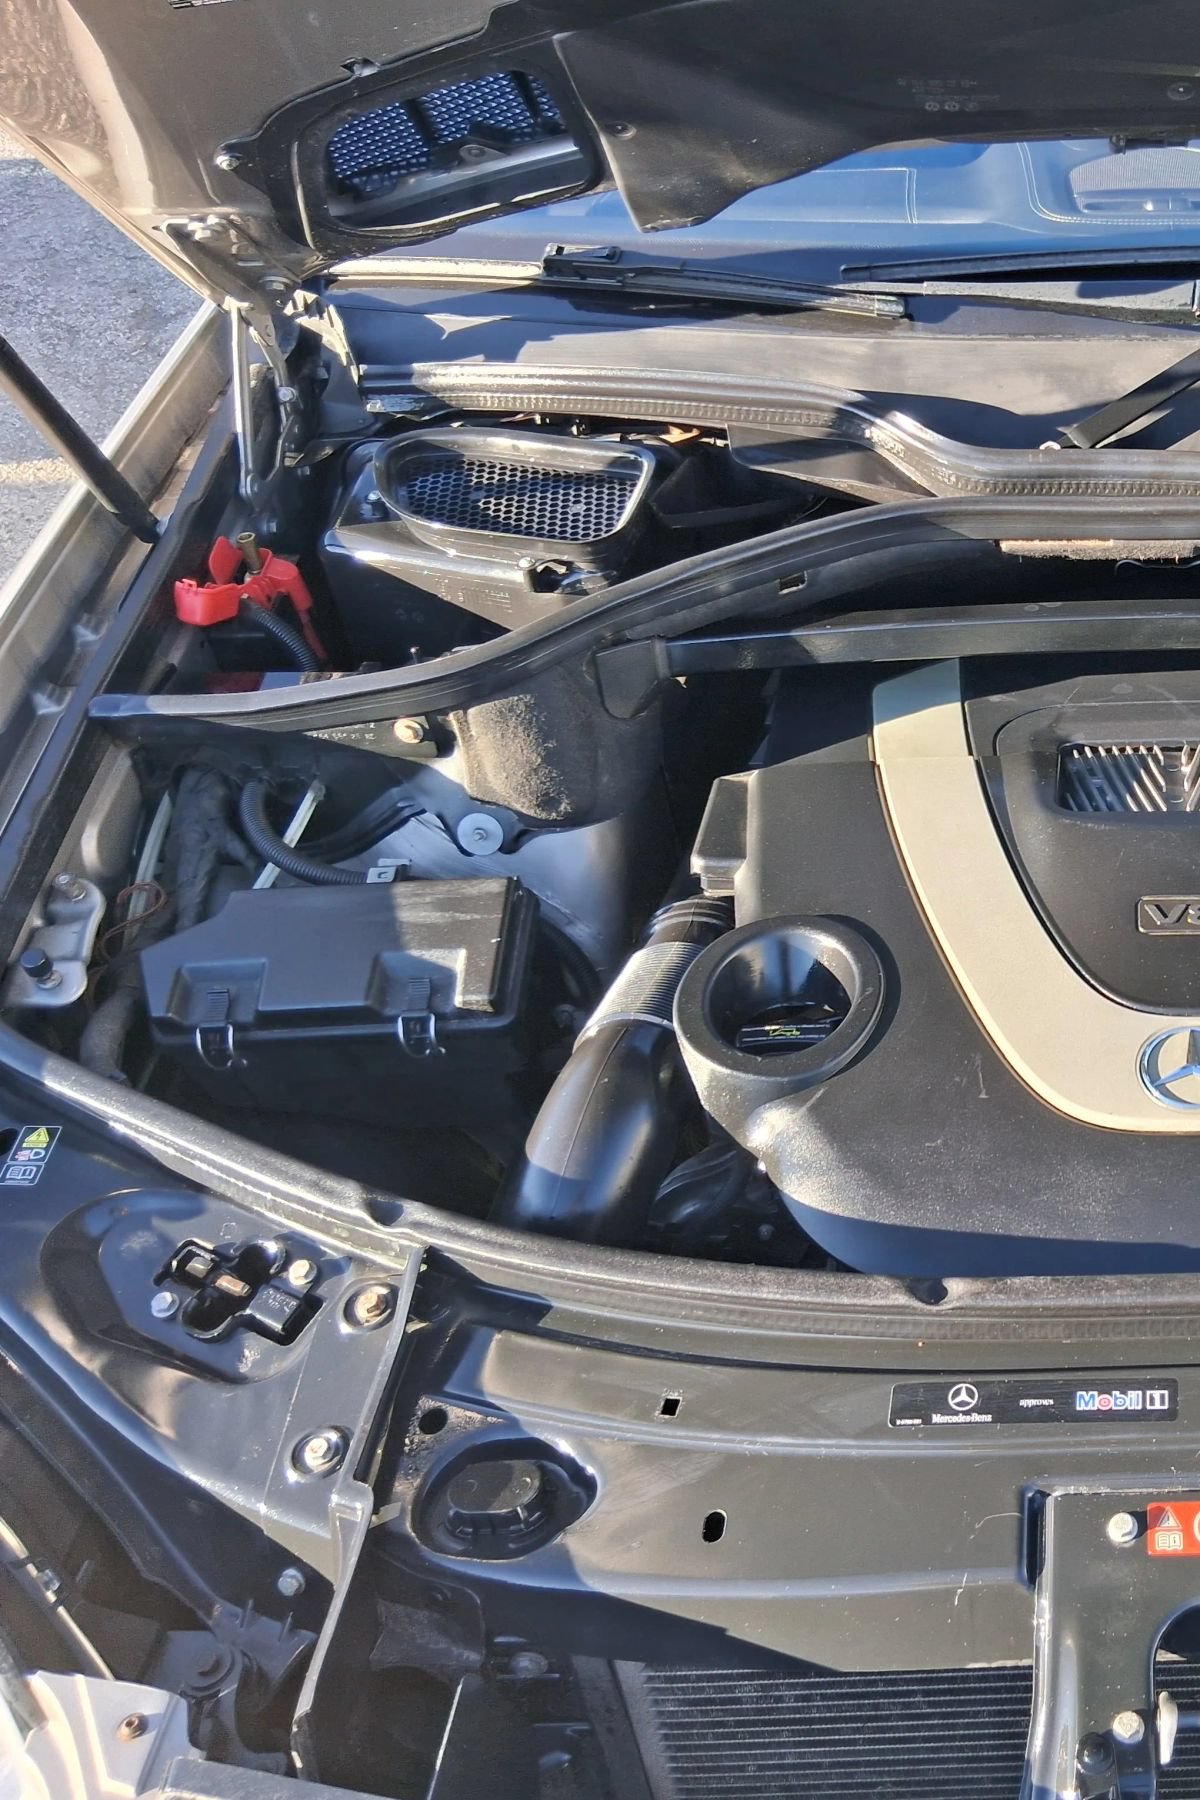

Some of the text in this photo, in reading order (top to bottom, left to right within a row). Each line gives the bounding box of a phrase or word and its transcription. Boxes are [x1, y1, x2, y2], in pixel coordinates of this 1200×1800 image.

[1019, 1399, 1054, 1408] approves
[1076, 1390, 1142, 1410] Mobil
[932, 1413, 992, 1424] Mercedes-Benz
